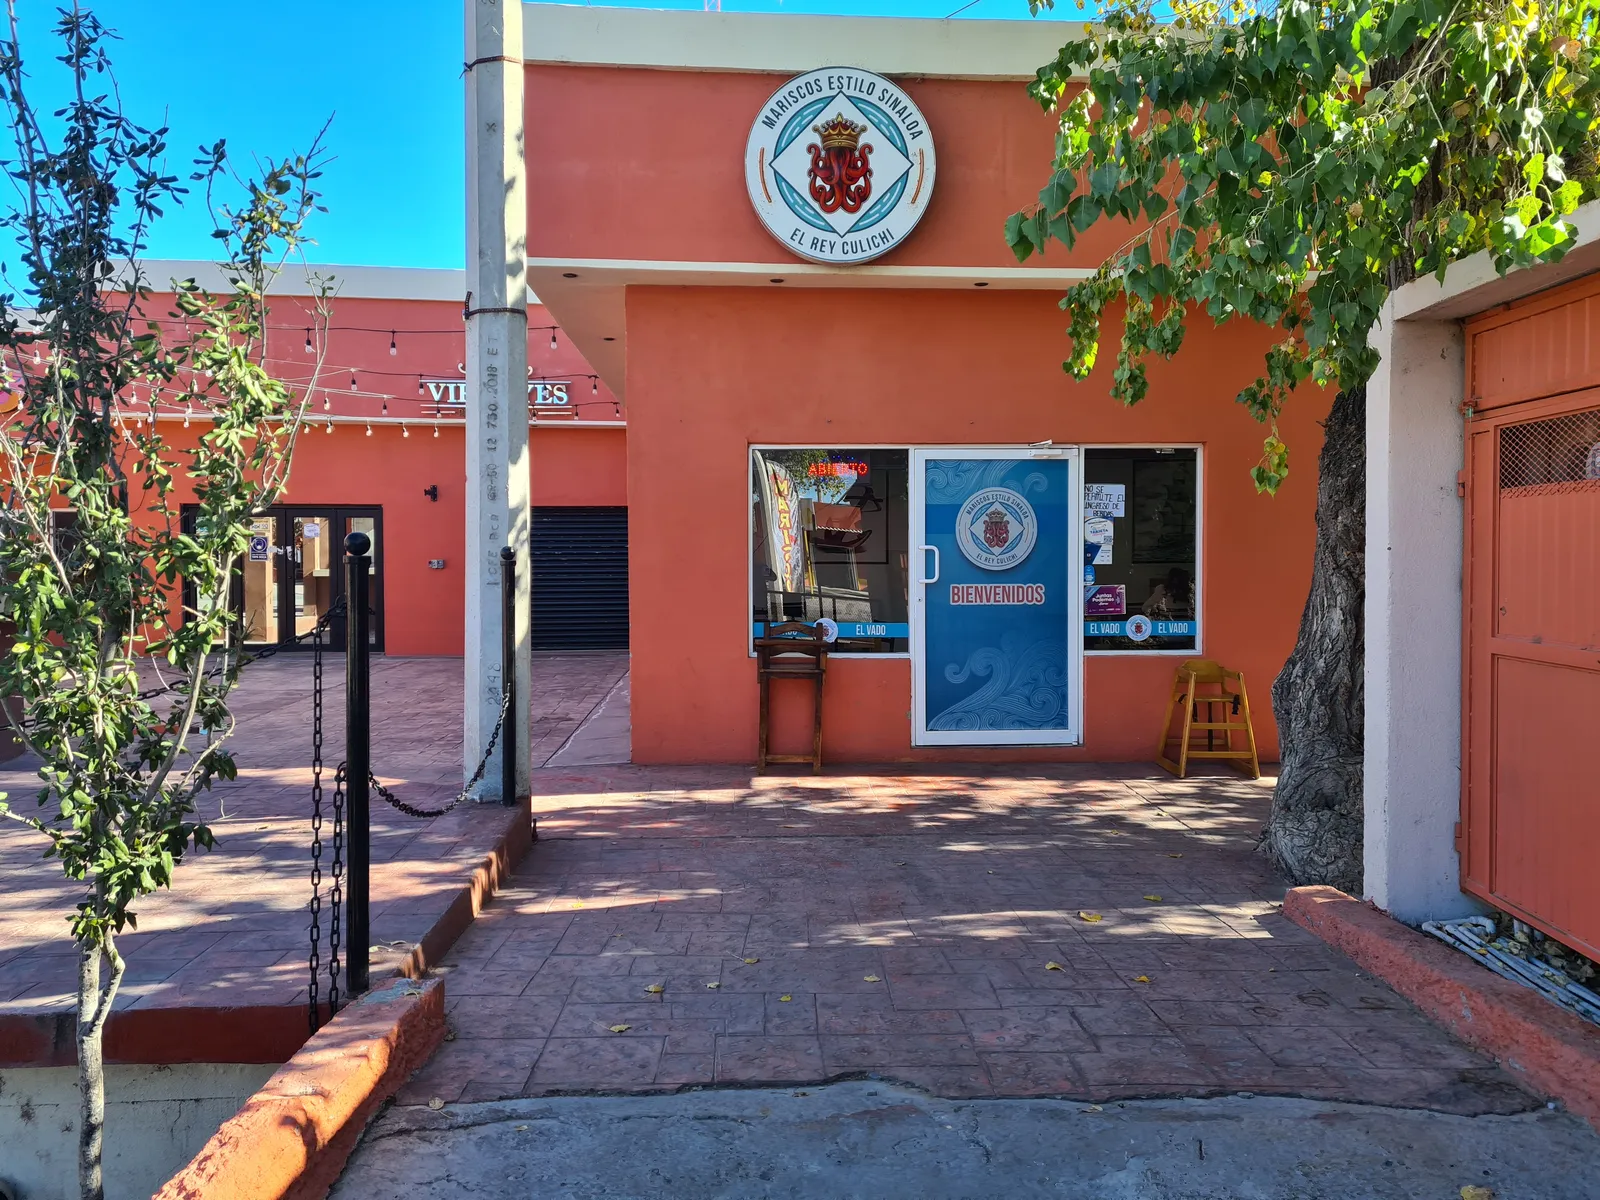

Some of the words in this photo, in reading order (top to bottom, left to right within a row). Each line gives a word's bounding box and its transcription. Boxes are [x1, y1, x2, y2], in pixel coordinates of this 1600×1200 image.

[762, 78, 823, 130] MARISCOS
[828, 75, 876, 96] ESTILO
[878, 88, 924, 141] SINALOA
[790, 227, 804, 246] EL
[810, 236, 836, 255] REY
[841, 227, 895, 255] CULICHI
[807, 462, 869, 477] ABIERTO
[1084, 485, 1094, 493] NO
[1095, 485, 1105, 494] SE
[1117, 494, 1126, 503] EL
[966, 495, 991, 515] MARISCOS
[991, 494, 1011, 502] ESTILO
[1011, 498, 1029, 519] SINALOA
[976, 552, 983, 560] EL
[996, 553, 1018, 564] CULICHI
[951, 585, 1045, 604] BIENVENIDOS
[856, 624, 865, 635] EL
[866, 624, 886, 635] VADO
[1090, 623, 1099, 634] EL
[1100, 623, 1120, 634] VADO
[1158, 623, 1167, 634] EL
[1168, 623, 1188, 633] VADO
